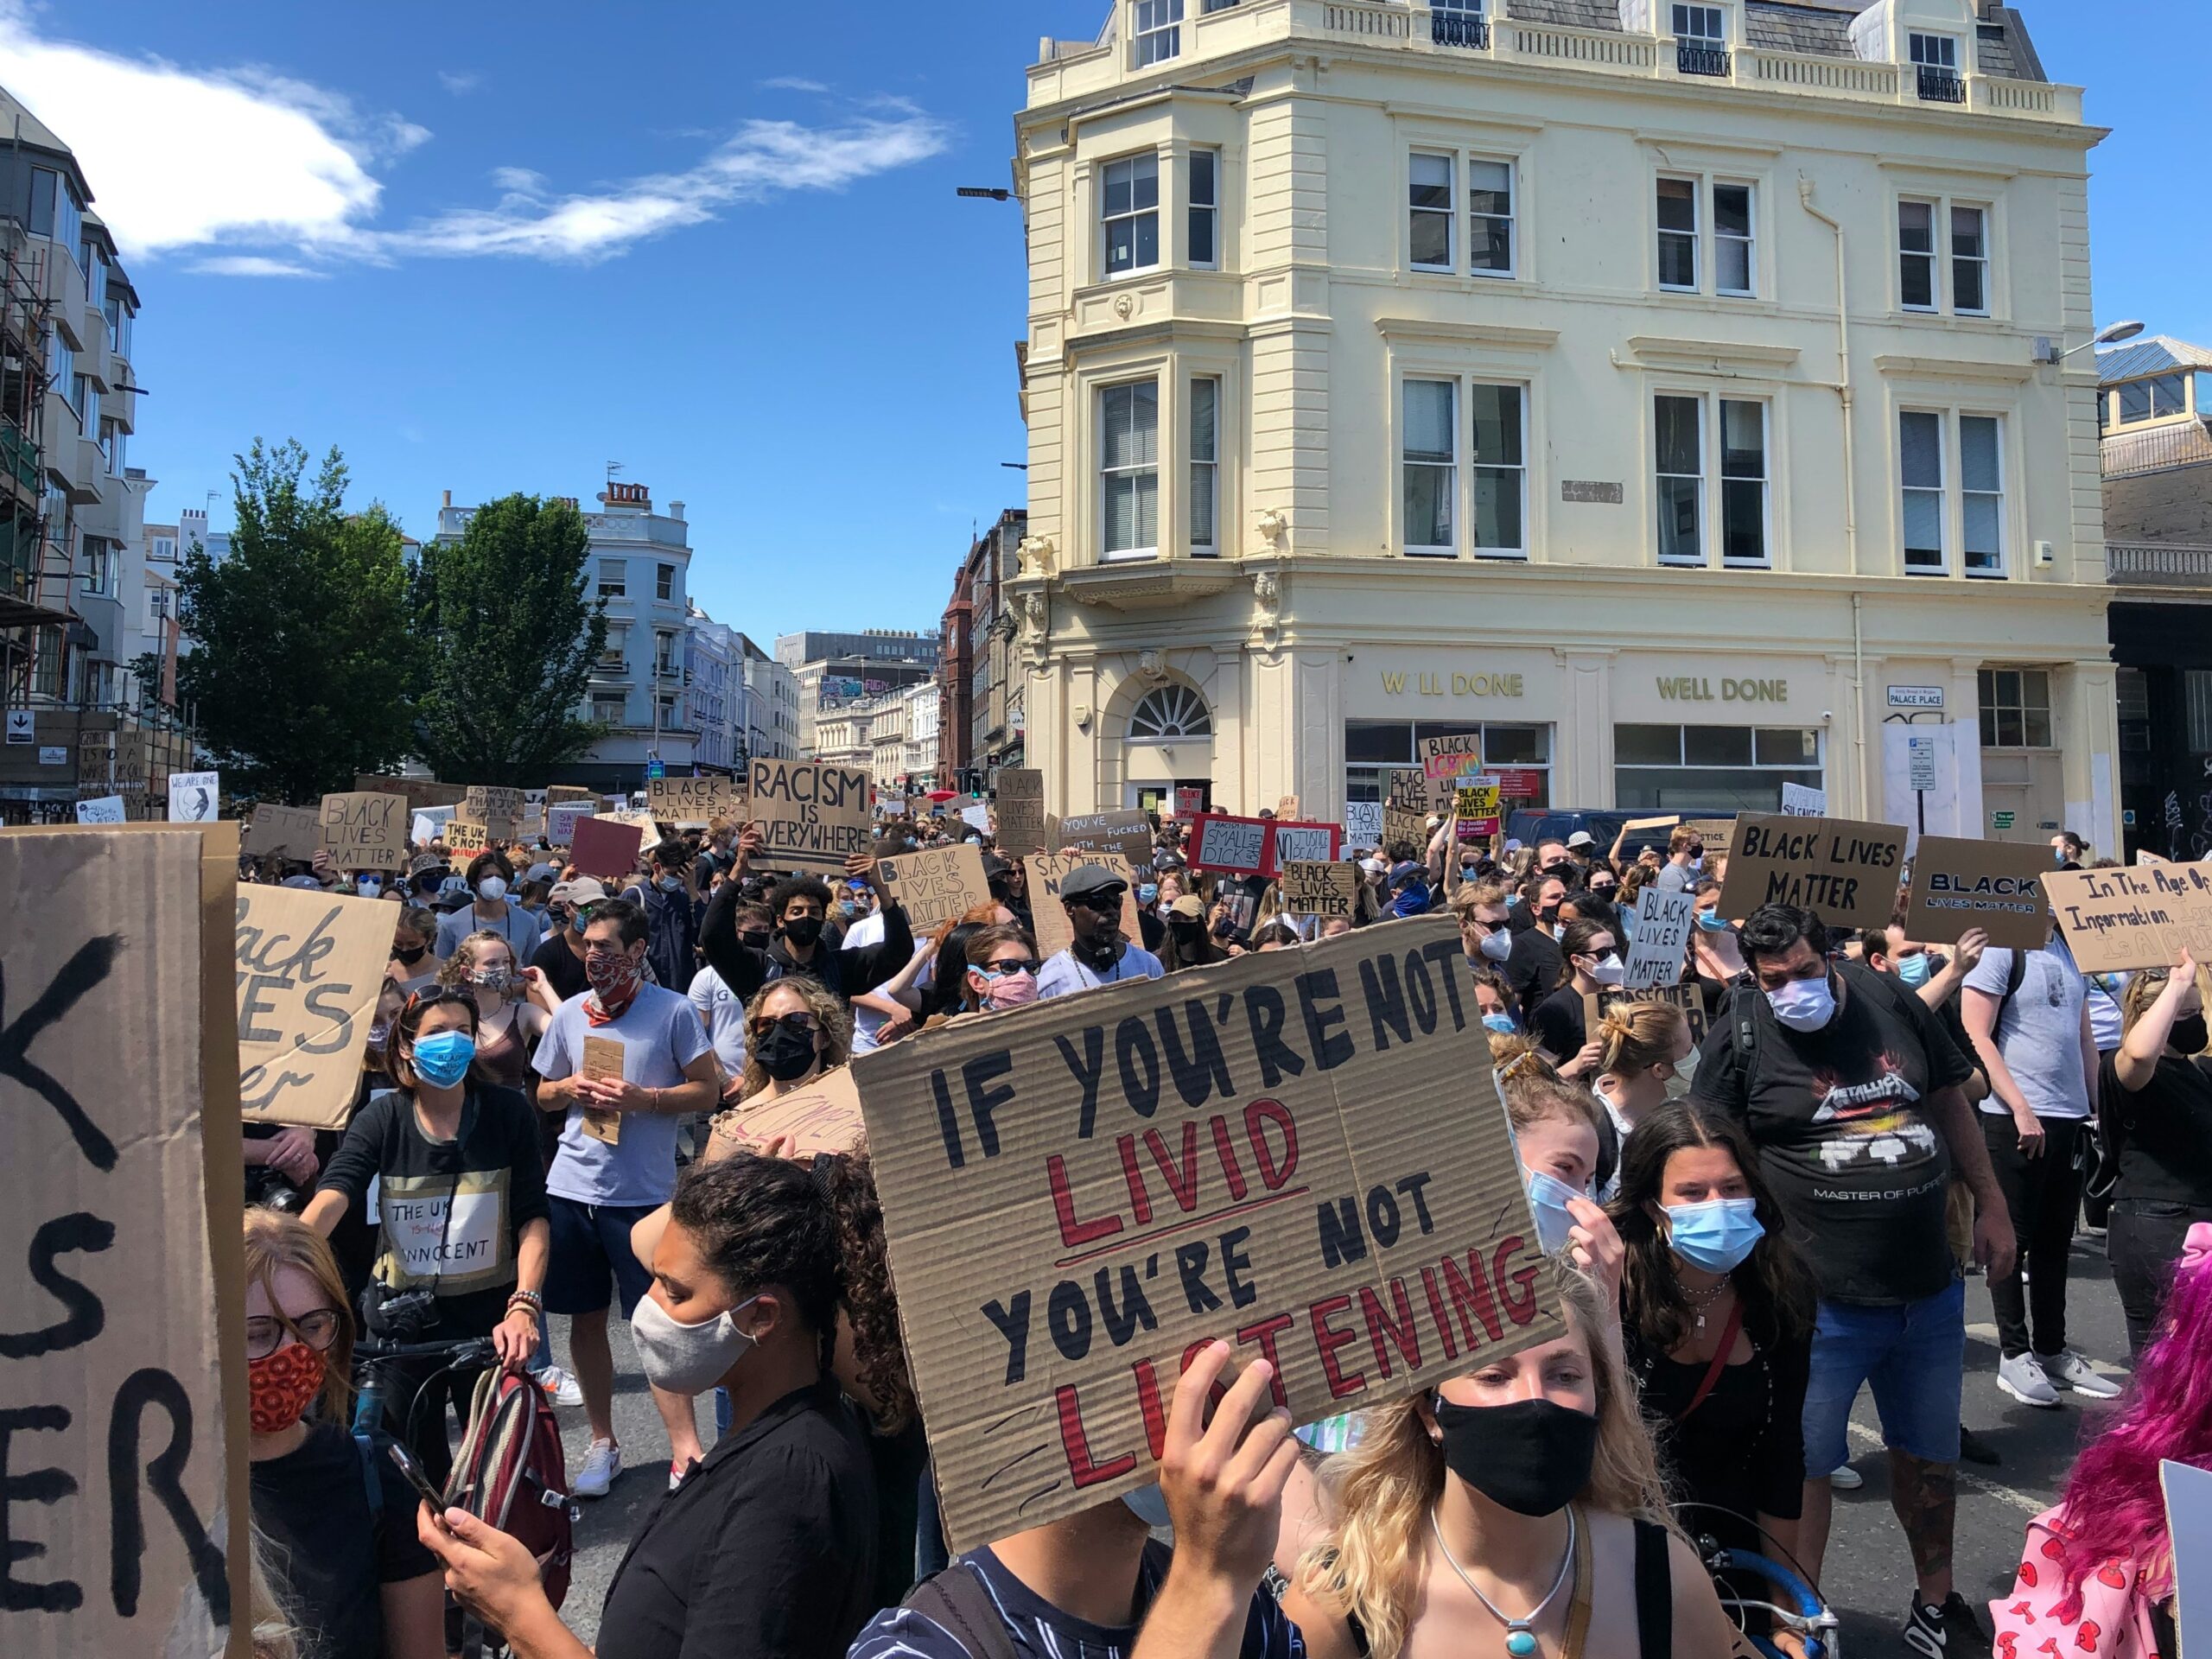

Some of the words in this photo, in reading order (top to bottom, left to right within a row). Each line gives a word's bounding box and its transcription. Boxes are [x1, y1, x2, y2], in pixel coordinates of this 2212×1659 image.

[1452, 671, 1522, 696] DONE
[1656, 677, 1715, 701] WELL
[1721, 678, 1788, 702] DONE
[1890, 695, 1916, 703] PALACE
[1919, 696, 1941, 704] PLACE
[1428, 736, 1474, 756] BLACK
[172, 777, 185, 788] WE
[186, 776, 199, 786] ARE
[652, 780, 721, 796] BLACK
[753, 762, 865, 812] RACISM
[999, 777, 1043, 796] BLACK
[467, 796, 495, 807] THAN
[667, 796, 716, 807] LIVES
[1459, 787, 1491, 798] BLACK
[1784, 785, 1826, 810] WHITE
[327, 797, 397, 828] BLACK
[1006, 800, 1035, 816] LIVES
[1390, 798, 1428, 812] MATTE
[1459, 798, 1485, 808] LIVES
[1459, 807, 1497, 817] MATTER
[655, 806, 728, 820] MATTER
[801, 804, 819, 824] IS
[1385, 810, 1418, 830] BLACK
[448, 823, 467, 837] THE
[471, 825, 486, 839] UK
[999, 816, 1044, 830] MATTER
[1063, 815, 1107, 833] YOU'VE
[1107, 823, 1147, 839] FUCKED
[1349, 822, 1382, 831] LIVES
[325, 827, 386, 844] LIVES
[449, 836, 457, 845] IS
[461, 837, 483, 849] NOT
[1205, 829, 1249, 849] SMALL
[1350, 832, 1382, 845] MATTE
[1384, 827, 1423, 846] LIVES
[1101, 842, 1123, 851] THE
[1204, 847, 1244, 864] DICK
[1276, 832, 1293, 866] NO
[1294, 830, 1328, 848] JUSTICE
[1293, 846, 1327, 861] PEACE
[1742, 826, 1819, 861] BLACK
[1830, 836, 1897, 868] LIVES
[327, 849, 395, 864] MATTER
[1034, 856, 1073, 876] SAY
[1078, 855, 1126, 873] THEIR
[879, 851, 960, 883] BLACK
[1291, 864, 1332, 881] BLACK
[892, 872, 964, 900] IVES
[1301, 881, 1339, 896] LIVES
[1765, 870, 1859, 910] MATTER
[1929, 873, 2039, 898] BLACK
[2079, 874, 2115, 899] In
[2111, 872, 2151, 895] The
[2152, 869, 2190, 896] Age
[2188, 868, 2212, 896] Of
[1287, 896, 1349, 914] MATTER
[1643, 892, 1688, 926] BLACK
[1926, 897, 1972, 909] LIVES
[1974, 900, 2036, 914] MATTER
[1638, 925, 1680, 946] LIVES
[2094, 934, 2133, 959] Is
[2134, 931, 2158, 959] A
[1629, 957, 1673, 982] MATTER
[1598, 983, 1694, 1014] POSECUTE
[236, 972, 353, 1054] ES
[931, 1049, 1016, 1168] IF
[1052, 966, 1356, 1139] YOU'RE
[1357, 938, 1469, 1052] NOT
[1046, 1097, 1300, 1249] LIVID
[1814, 1188, 1881, 1200] MASTER
[1884, 1190, 1904, 1199] OF
[392, 1205, 423, 1221] THE
[430, 1199, 452, 1217] UK
[980, 1224, 1257, 1387] YOU'RE
[1318, 1171, 1436, 1270] NOT
[0, 1367, 231, 1627] ER
